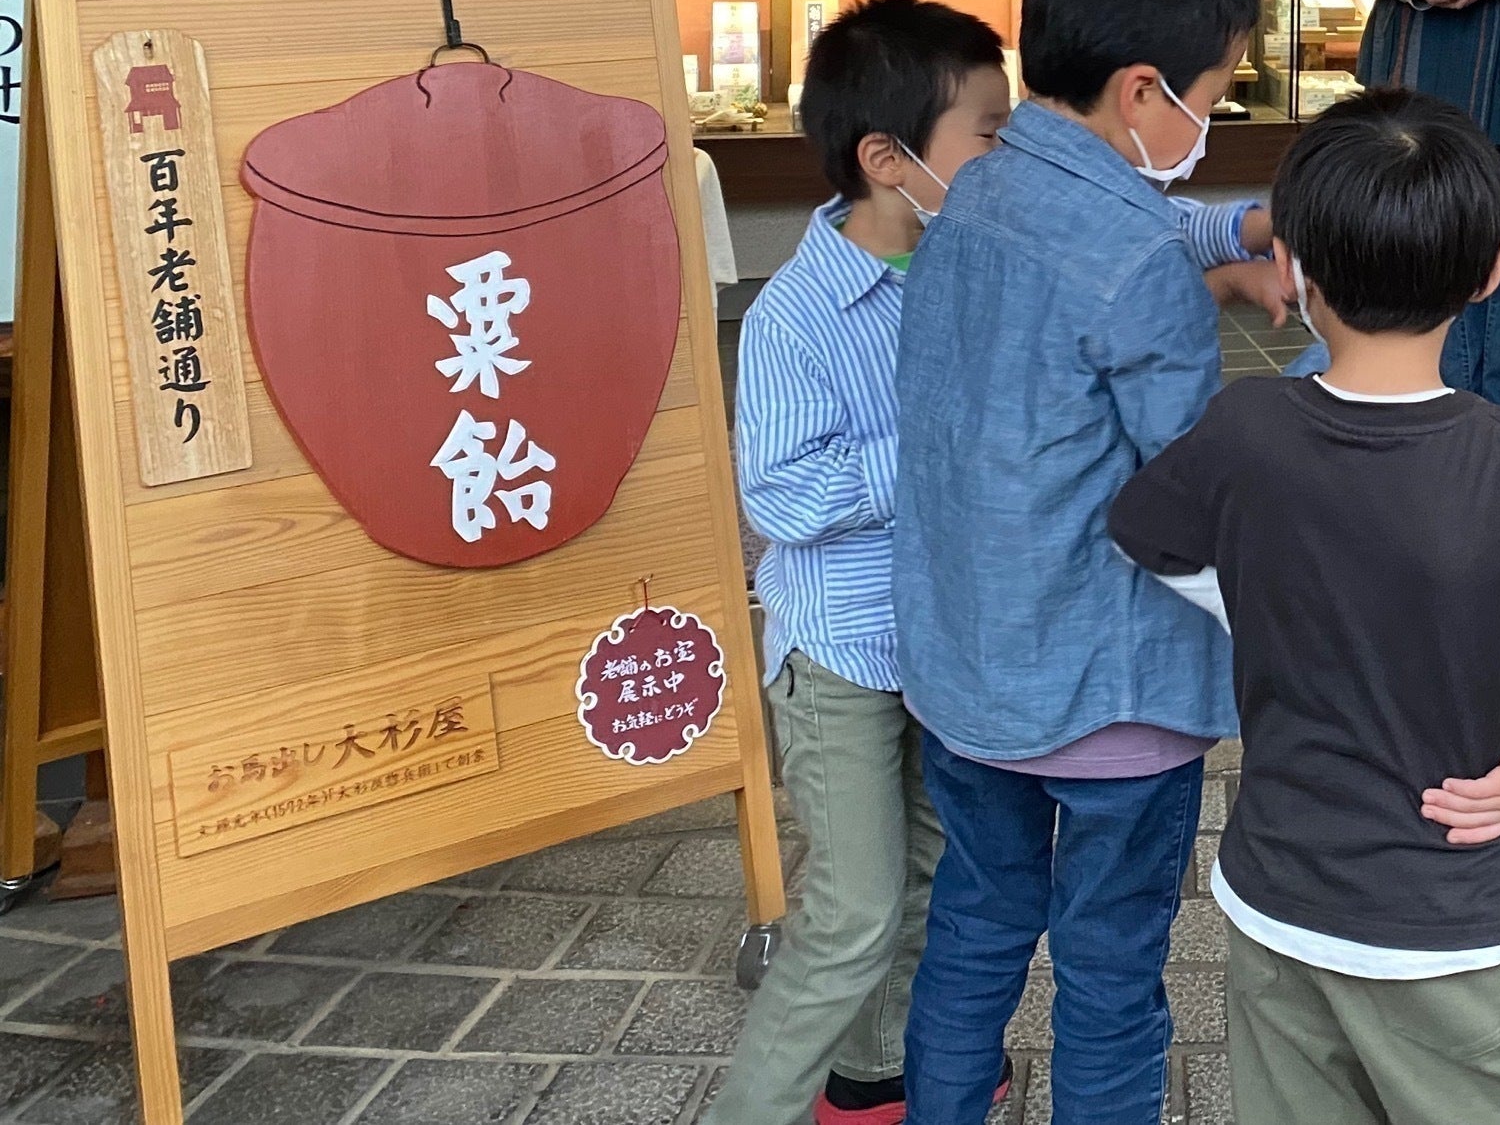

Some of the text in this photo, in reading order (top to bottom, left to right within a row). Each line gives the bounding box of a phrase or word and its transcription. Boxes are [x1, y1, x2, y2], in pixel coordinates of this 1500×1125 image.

[139, 148, 212, 444] 百年老舗通り
[600, 640, 696, 681] 老舗のお宝
[617, 670, 686, 704] 展示中
[611, 697, 699, 734] お気軽にどうぞ
